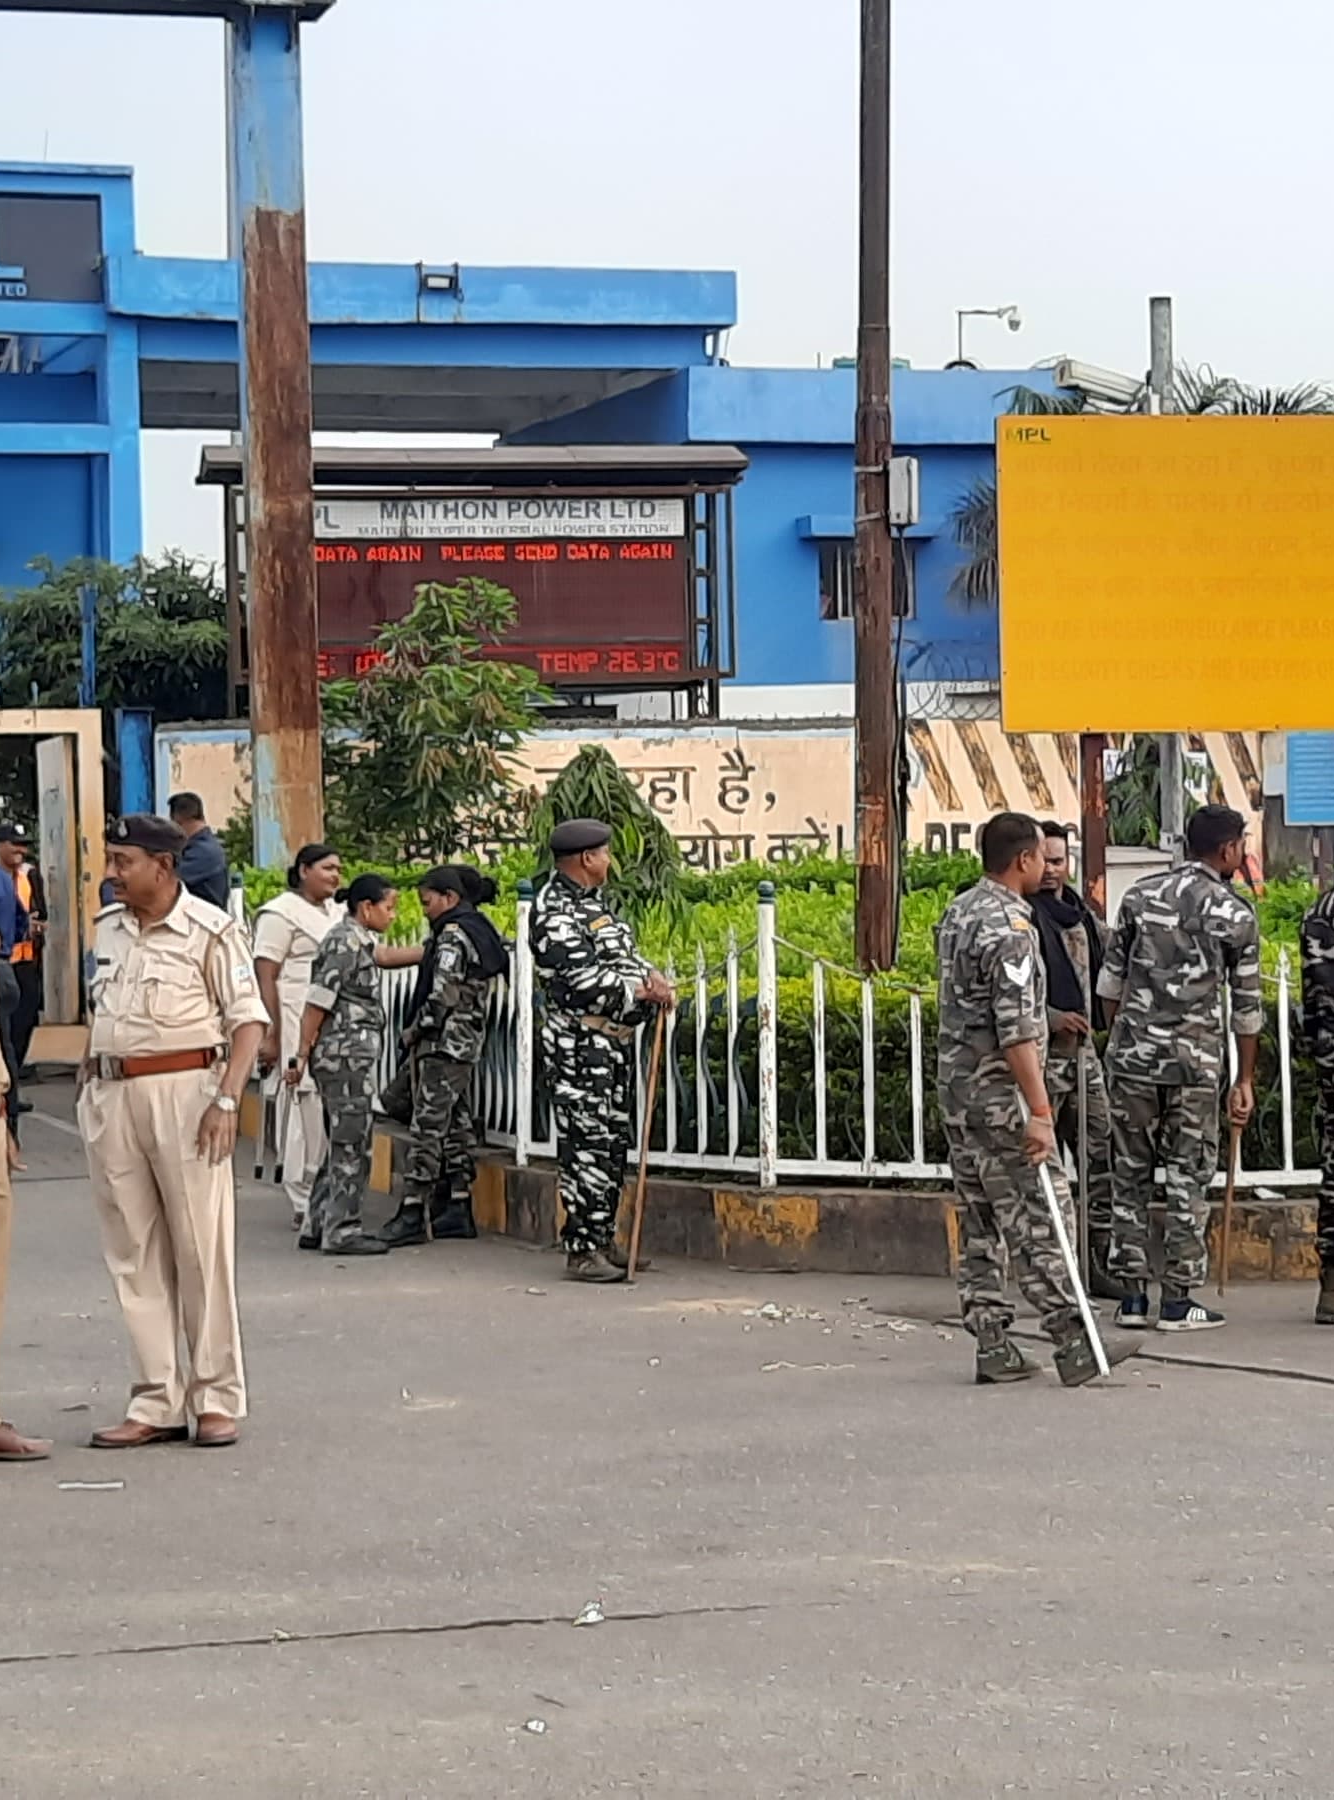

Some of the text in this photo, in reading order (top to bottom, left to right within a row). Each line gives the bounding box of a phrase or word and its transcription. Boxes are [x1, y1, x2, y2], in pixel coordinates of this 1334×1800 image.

[1005, 427, 1052, 442] MPL
[507, 499, 601, 519] POWER
[610, 499, 656, 519] LTD
[567, 544, 611, 560] DATA
[619, 543, 673, 560] AGAIN
